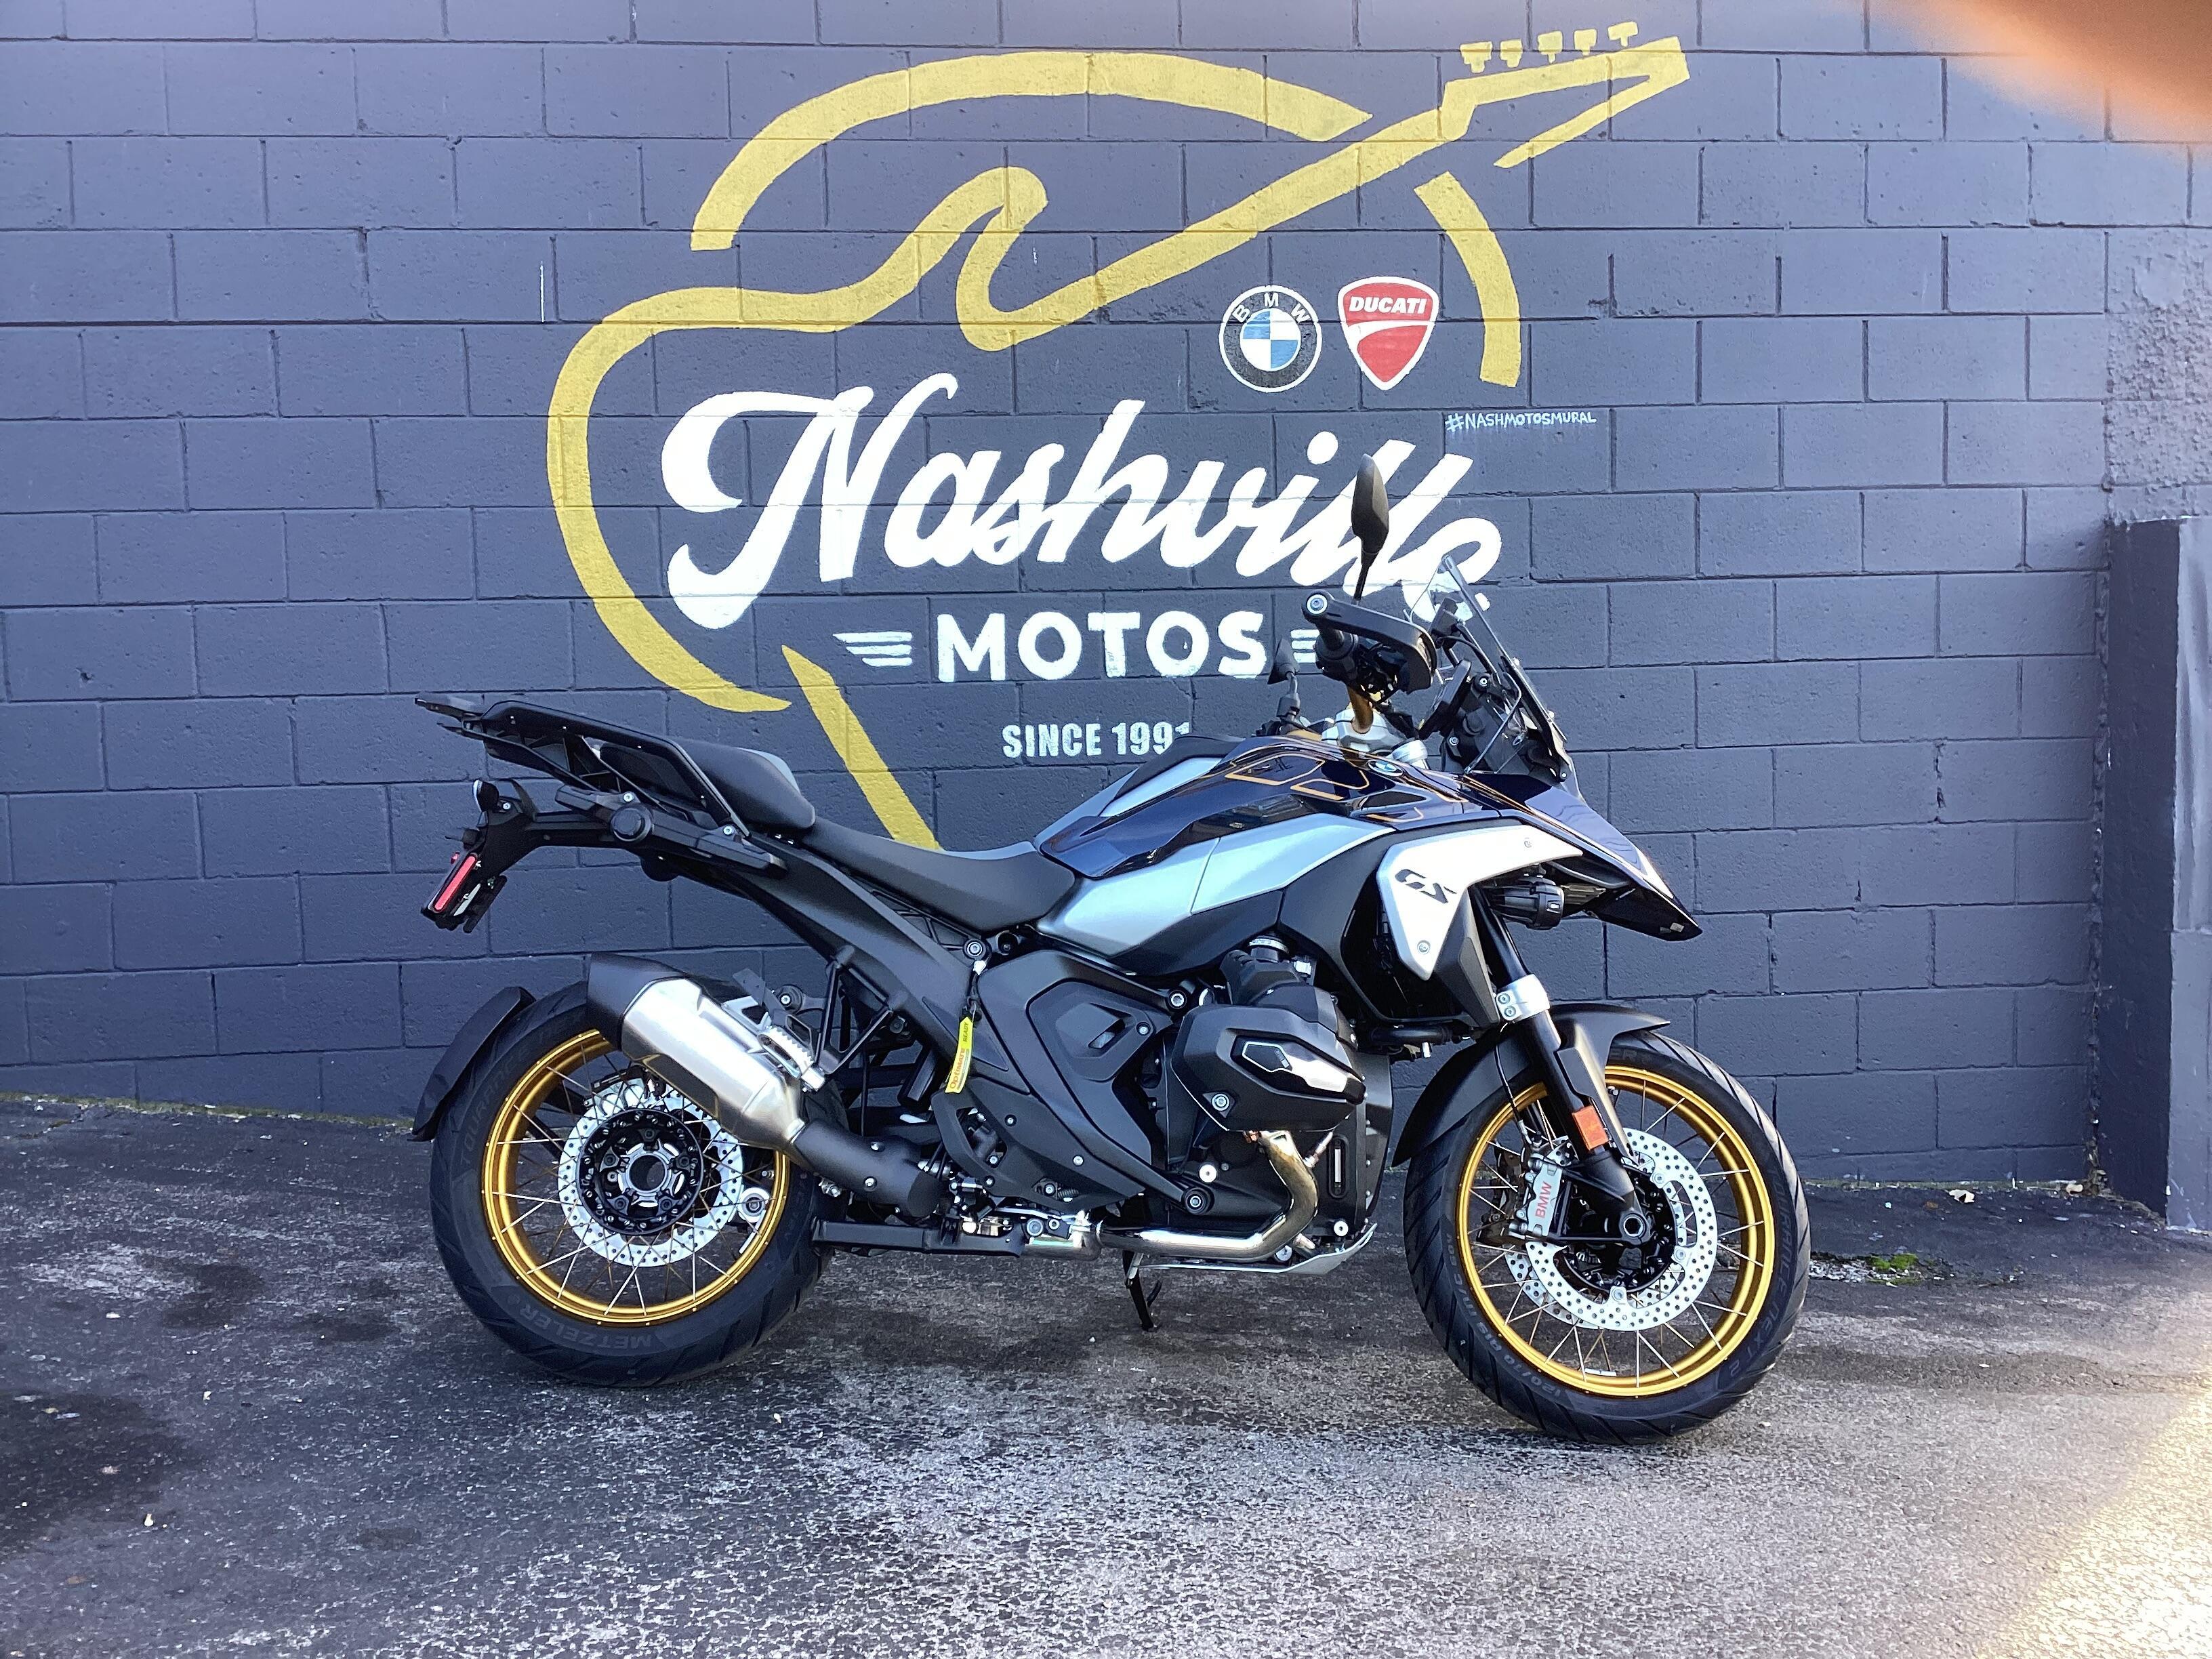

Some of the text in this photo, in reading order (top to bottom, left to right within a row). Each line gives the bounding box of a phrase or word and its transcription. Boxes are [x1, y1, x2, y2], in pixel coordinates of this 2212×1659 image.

[1231, 292, 1311, 324] BMW
[1349, 295, 1427, 315] DUCATI
[1444, 411, 1597, 432] #NASHMOTOSMURAL
[661, 373, 1502, 630] Nashville
[936, 610, 1267, 682] MOTOS
[1002, 722, 1103, 758] SINCE
[1535, 1181, 1552, 1219] BMW
[1766, 1164, 1795, 1298] TOURANCE
[519, 1303, 652, 1349] METZELER
[1728, 1358, 1741, 1378] 2
